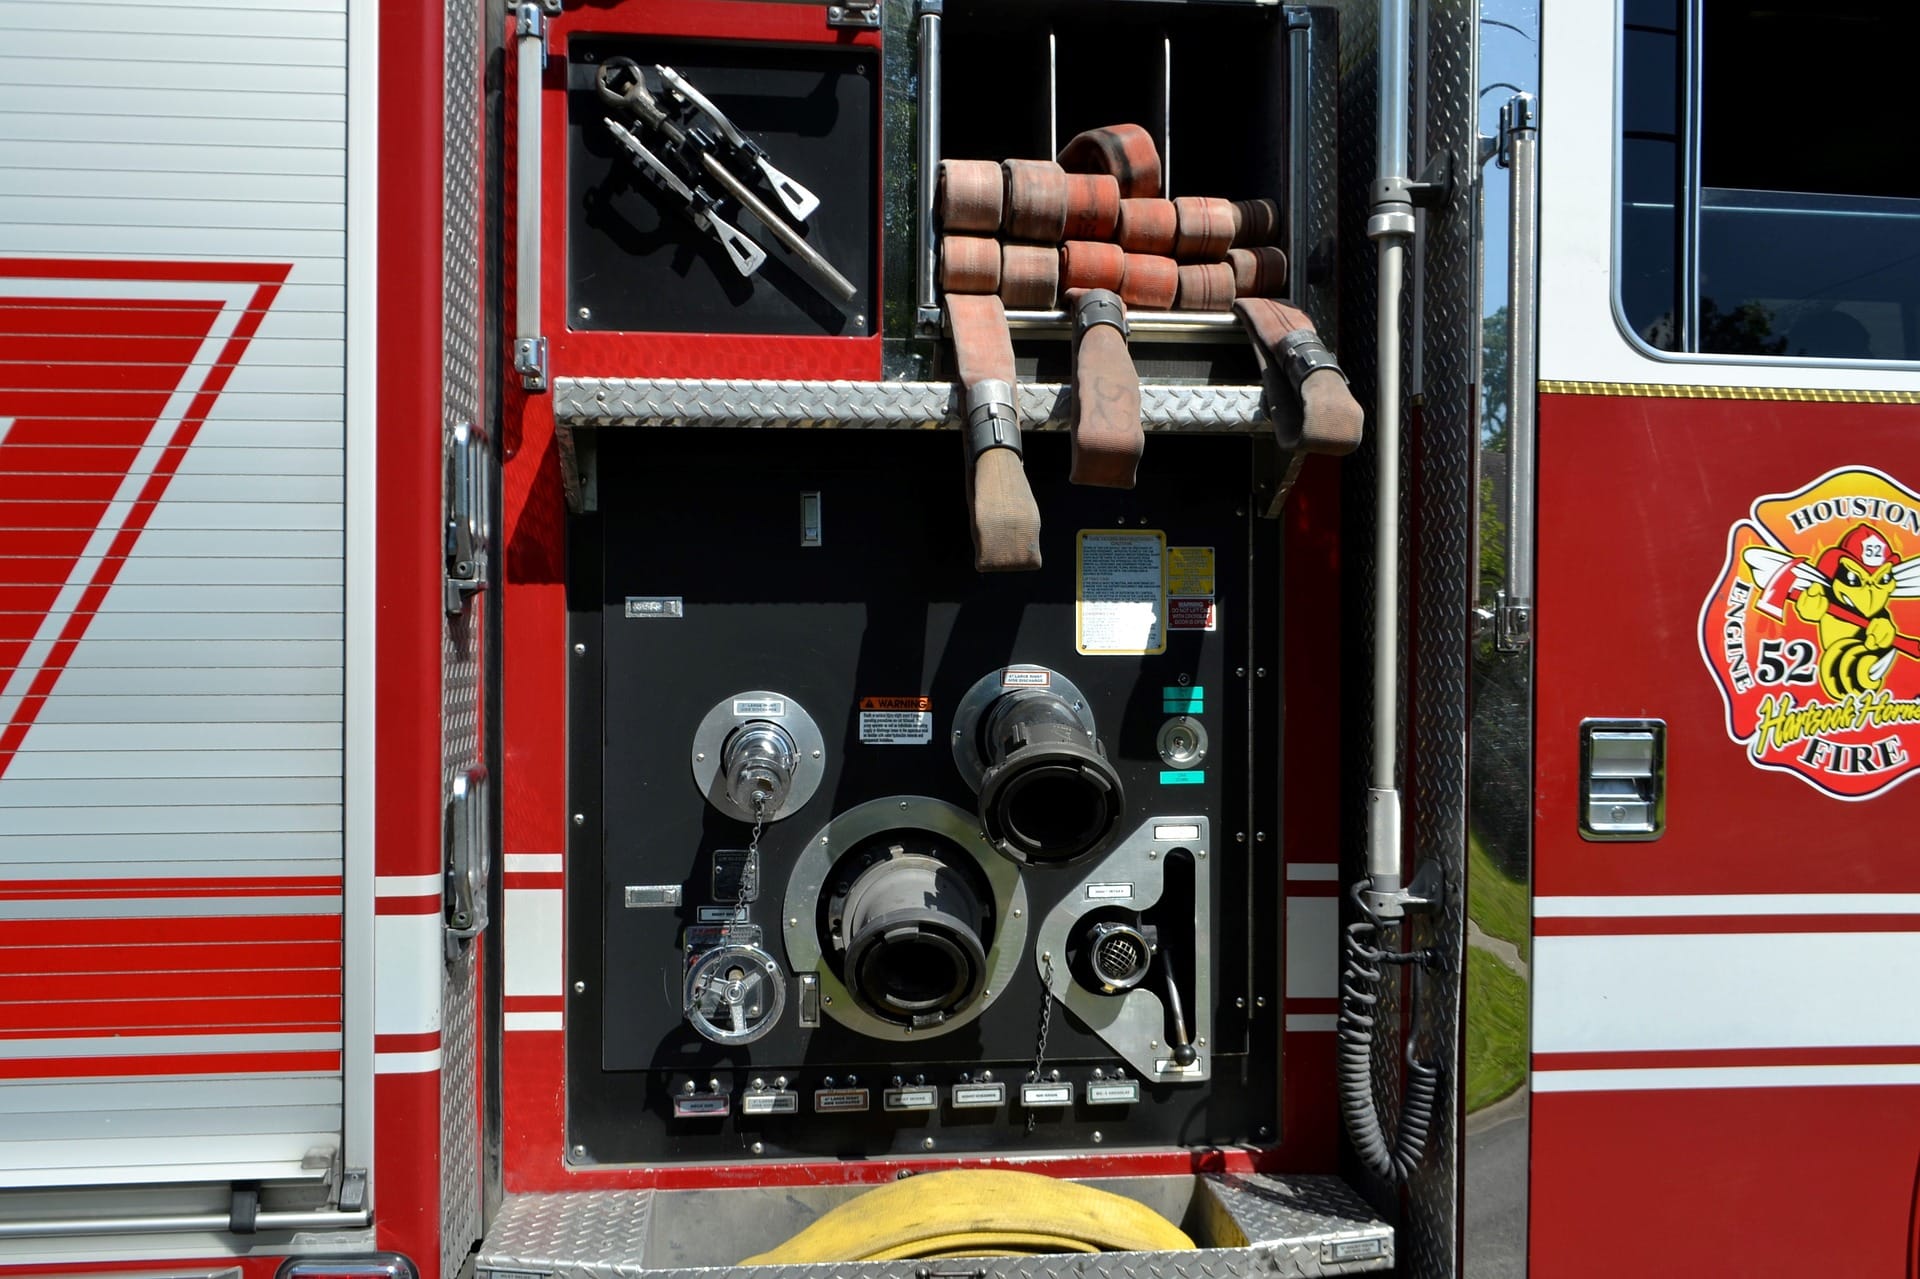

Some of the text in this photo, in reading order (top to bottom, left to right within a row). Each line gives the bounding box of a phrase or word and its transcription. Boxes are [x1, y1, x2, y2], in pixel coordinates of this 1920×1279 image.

[1790, 497, 1920, 533] HOUSTON
[1865, 544, 1882, 558] 52
[1726, 580, 1752, 691] ENGINE
[1759, 642, 1815, 682] 52
[878, 699, 928, 709] WARNING
[1757, 695, 1857, 755] Hartsook
[1801, 737, 1906, 773] FIRE
